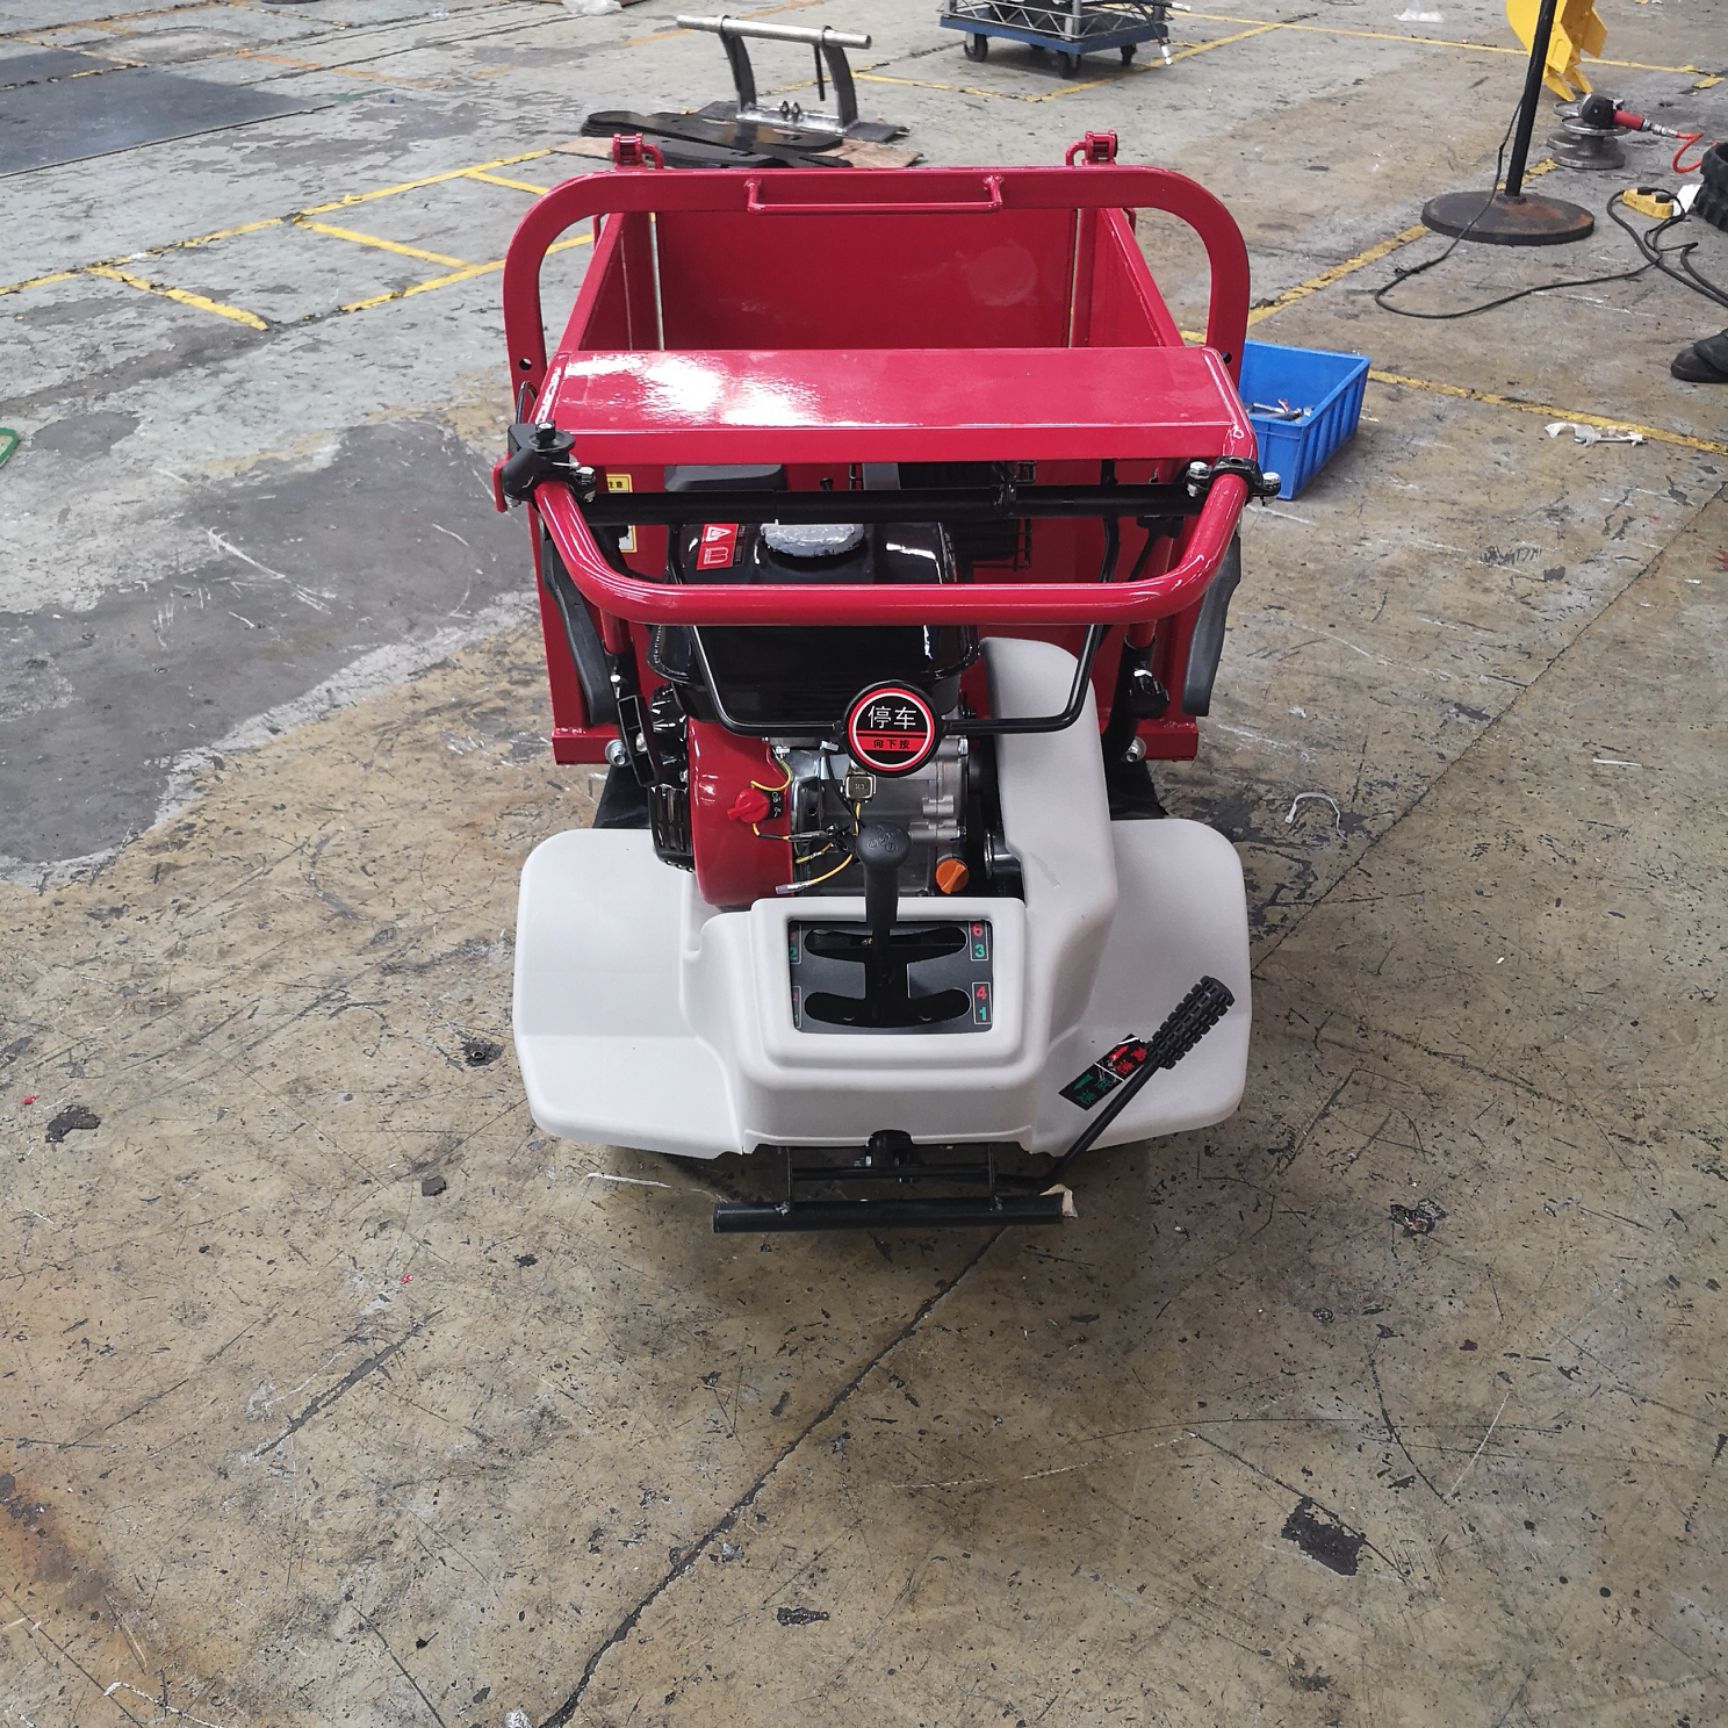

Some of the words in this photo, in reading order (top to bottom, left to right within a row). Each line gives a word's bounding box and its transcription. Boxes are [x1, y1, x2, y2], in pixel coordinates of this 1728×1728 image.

[868, 705, 917, 730] 停车
[975, 943, 985, 958] 3
[976, 985, 988, 1000] 4
[979, 1006, 987, 1021] 1
